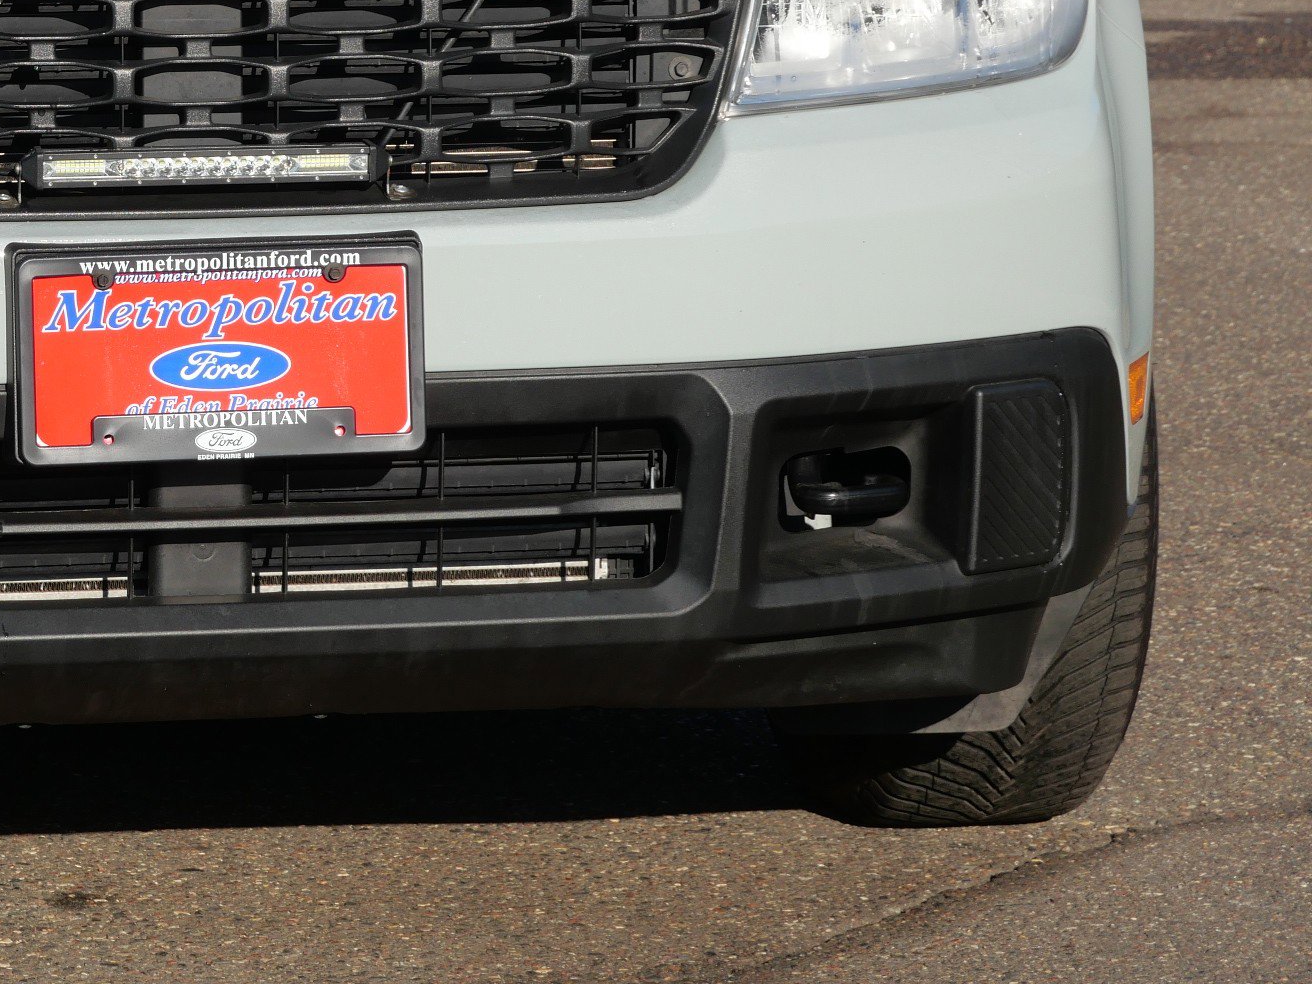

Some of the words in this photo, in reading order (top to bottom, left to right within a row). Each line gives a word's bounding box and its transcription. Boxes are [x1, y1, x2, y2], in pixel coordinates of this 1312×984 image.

[79, 250, 361, 277] www.metropolitanford.com
[42, 280, 398, 340] Metropolitan
[180, 349, 260, 381] Ford
[124, 395, 158, 415] of
[159, 395, 223, 414] Eden
[229, 391, 319, 412] Prairie
[143, 409, 309, 430] METROPOLITAN
[208, 432, 243, 447] Ford
[197, 453, 215, 461] EDEN
[215, 452, 242, 460] PRAIRIE
